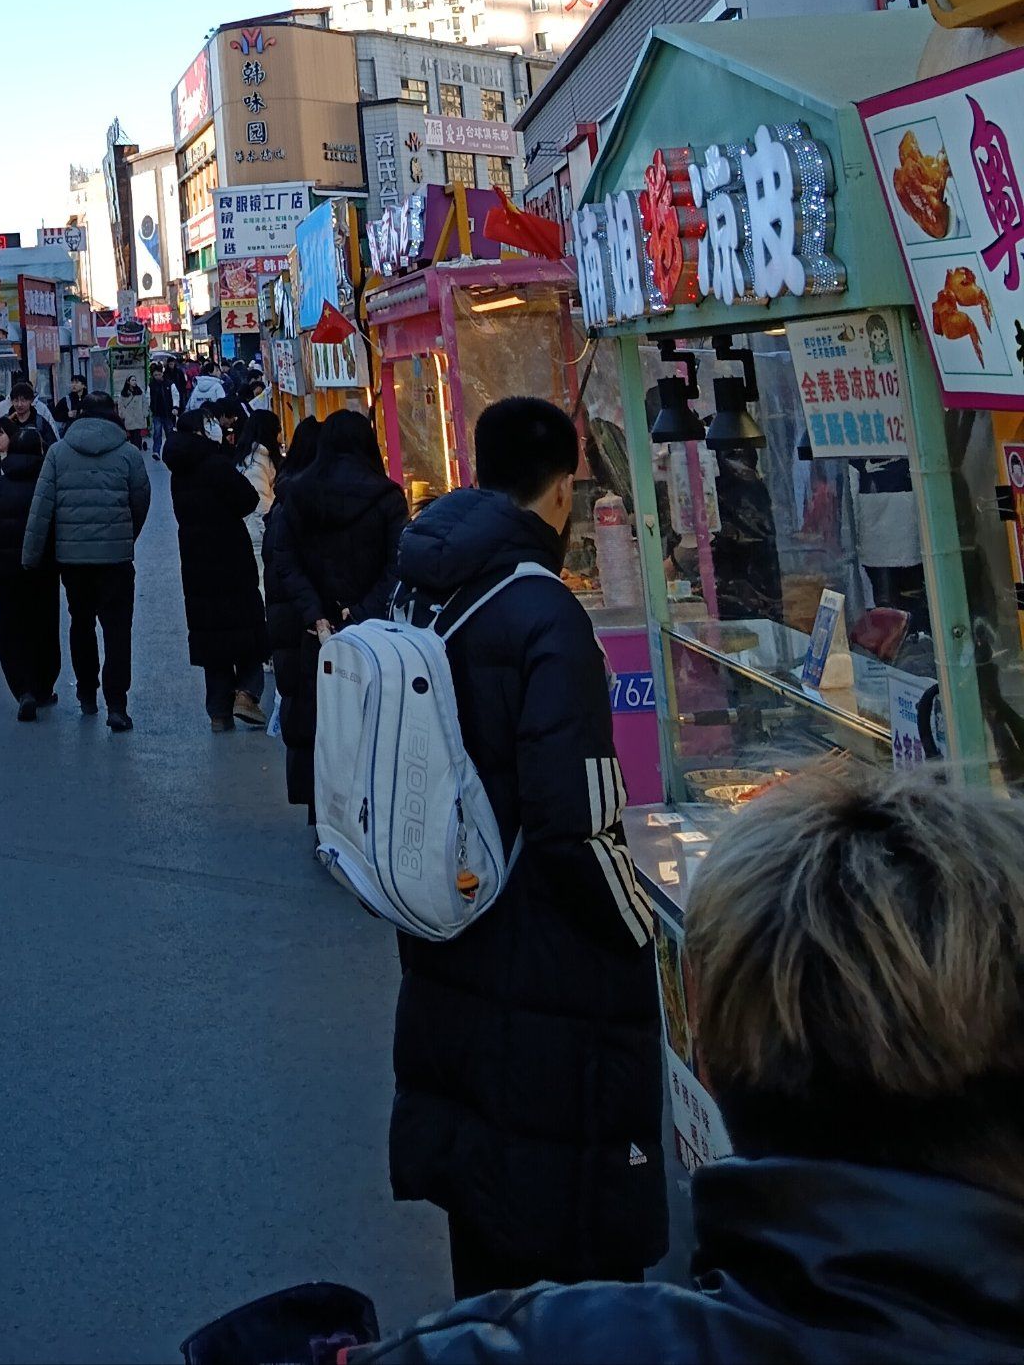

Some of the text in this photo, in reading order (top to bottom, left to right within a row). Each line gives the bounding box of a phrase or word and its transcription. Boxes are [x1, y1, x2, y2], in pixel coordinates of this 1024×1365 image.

[241, 60, 268, 145] 韩味园
[445, 124, 510, 145] 爱马台球俱乐部
[235, 192, 304, 213] 眼镜工厂店
[219, 196, 237, 255] 良镜优选
[43, 237, 63, 245] KFC
[263, 259, 291, 272] 韩味
[801, 365, 881, 404] 全素卷凉皮
